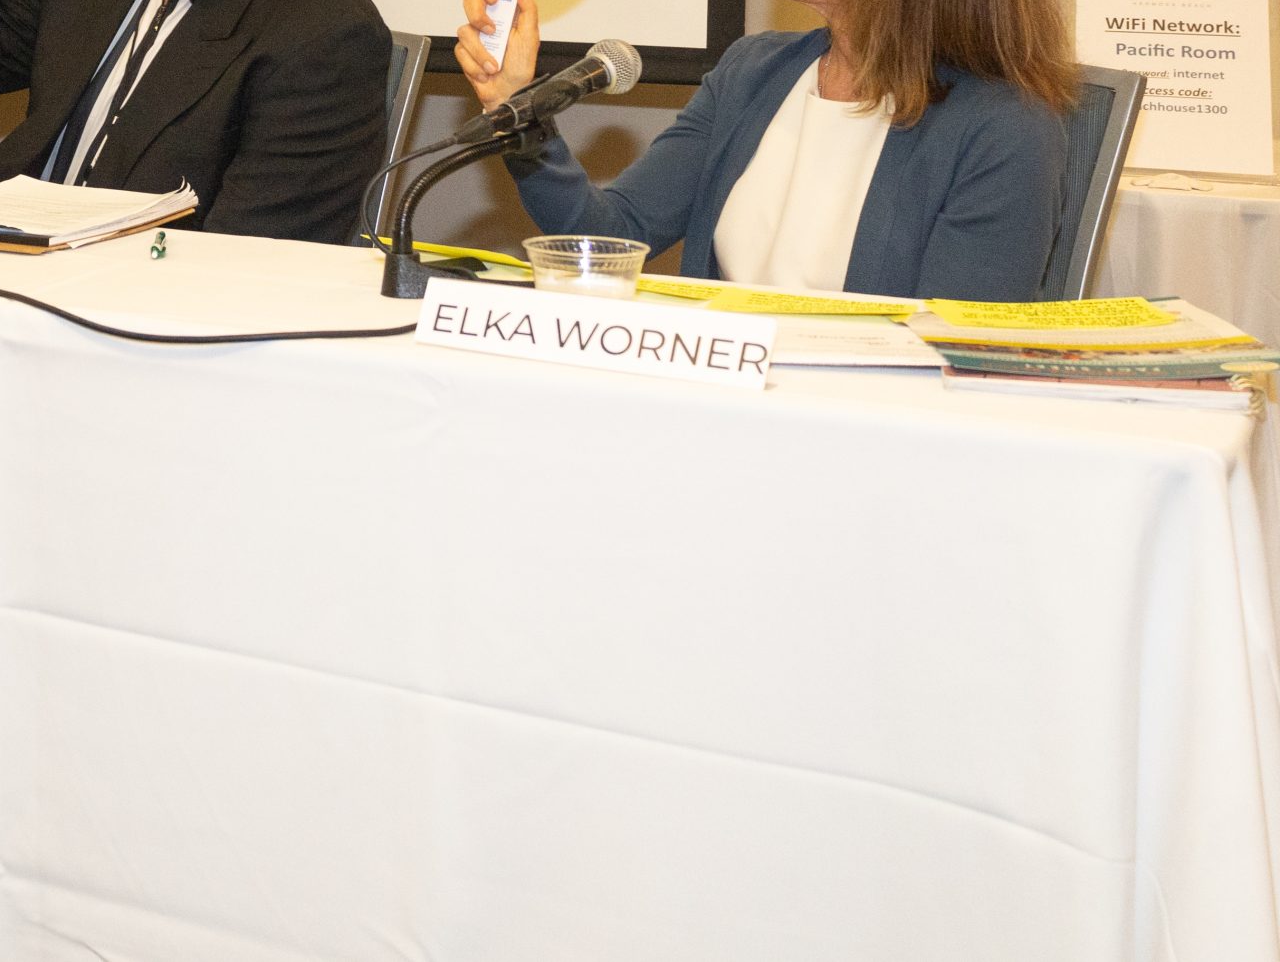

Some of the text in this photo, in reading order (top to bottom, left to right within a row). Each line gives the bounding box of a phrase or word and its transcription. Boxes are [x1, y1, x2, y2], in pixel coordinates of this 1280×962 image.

[1105, 17, 1241, 35] WiFi Network:
[1115, 42, 1236, 60] Pacific Room
[1173, 69, 1225, 80] internet
[1143, 86, 1213, 98] ccess code:
[432, 303, 769, 375] ELKA WORNER
